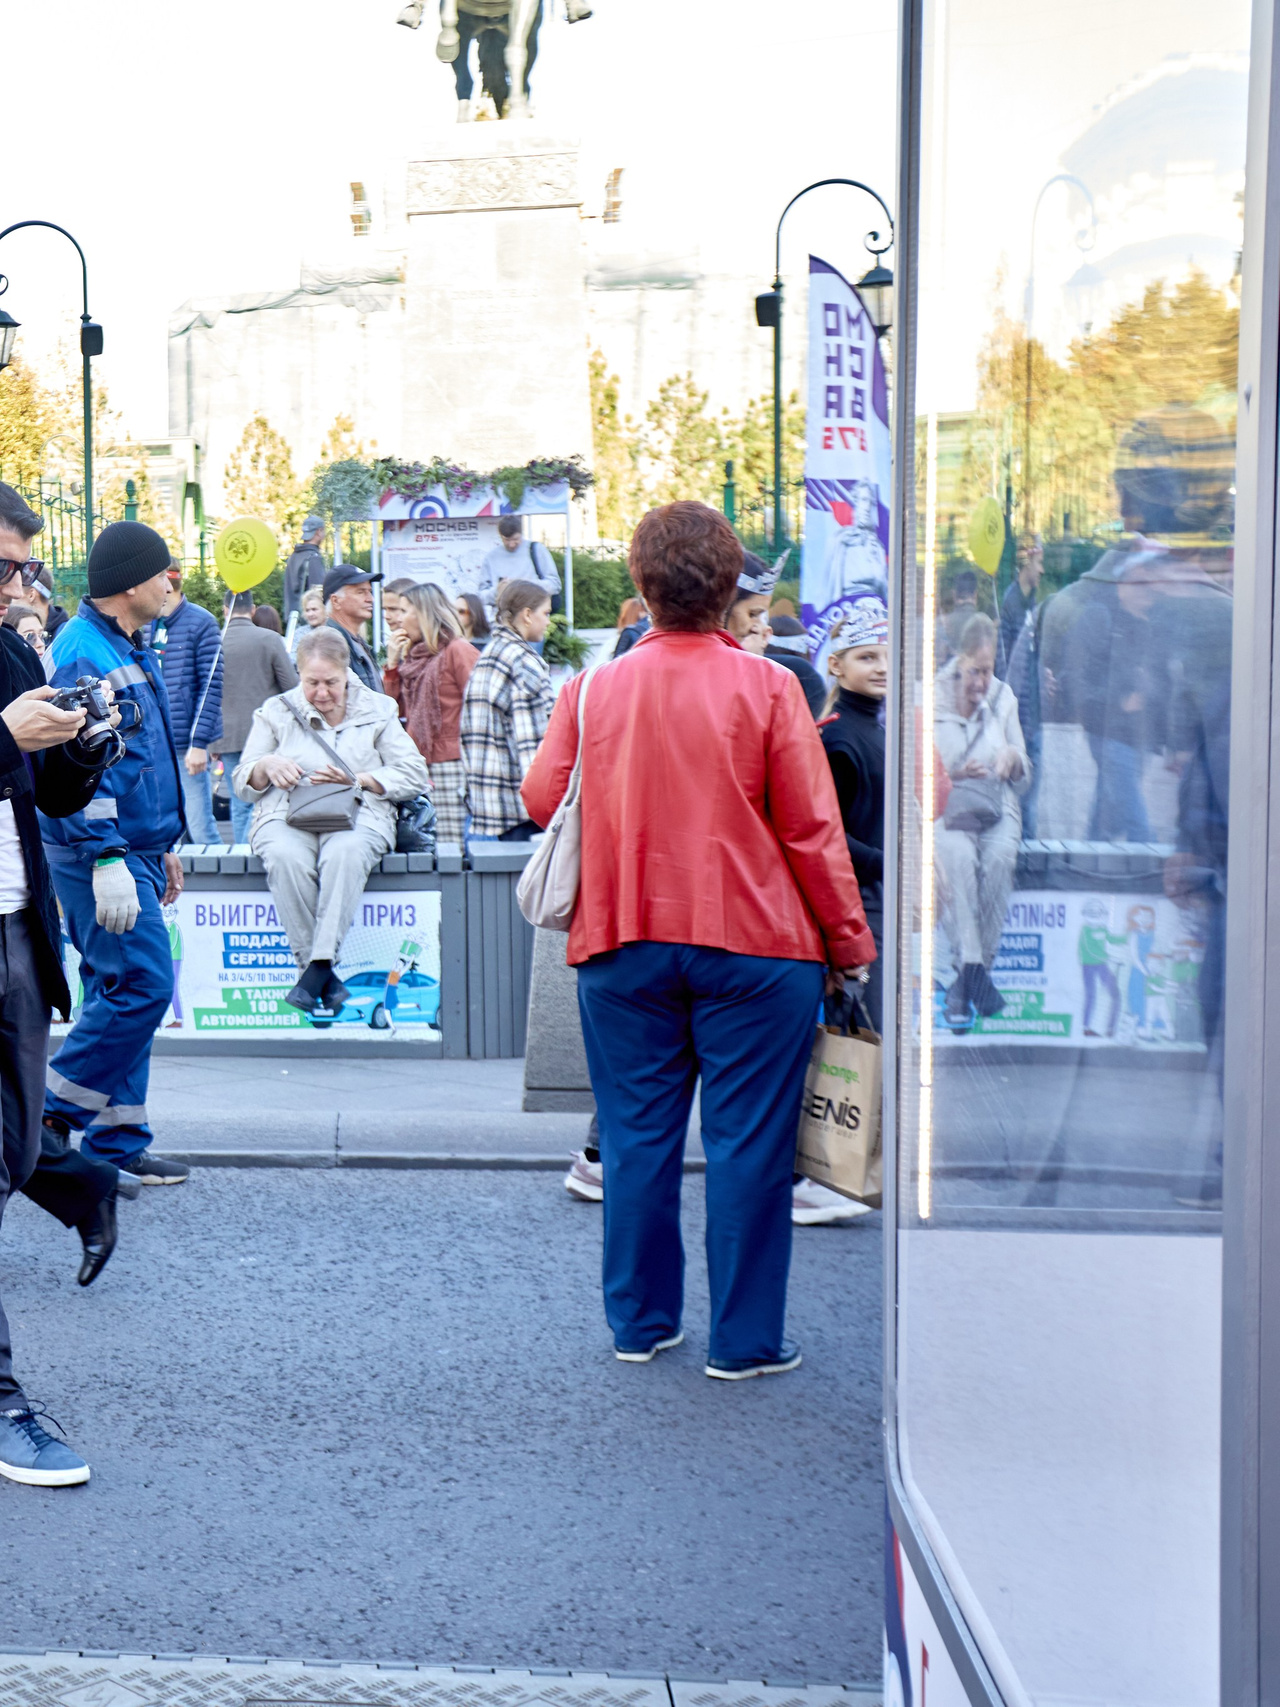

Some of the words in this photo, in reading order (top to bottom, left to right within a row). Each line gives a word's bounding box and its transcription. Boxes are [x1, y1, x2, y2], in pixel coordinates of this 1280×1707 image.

[415, 521, 479, 533] МОСКВА
[415, 534, 439, 543] 875
[195, 904, 282, 926] ВЫИГРА
[363, 904, 416, 927] ПРИЗ
[229, 935, 290, 949] ПОДАРО
[229, 952, 296, 966] СЕРТИФИ
[218, 973, 230, 982] НА
[231, 972, 267, 982] 3/4/5/10
[268, 972, 296, 982] ТЫСЯЧ
[232, 989, 242, 999] А
[250, 1001, 278, 1013] 100
[200, 1012, 300, 1027] АВТОМОБИЛЕЙ
